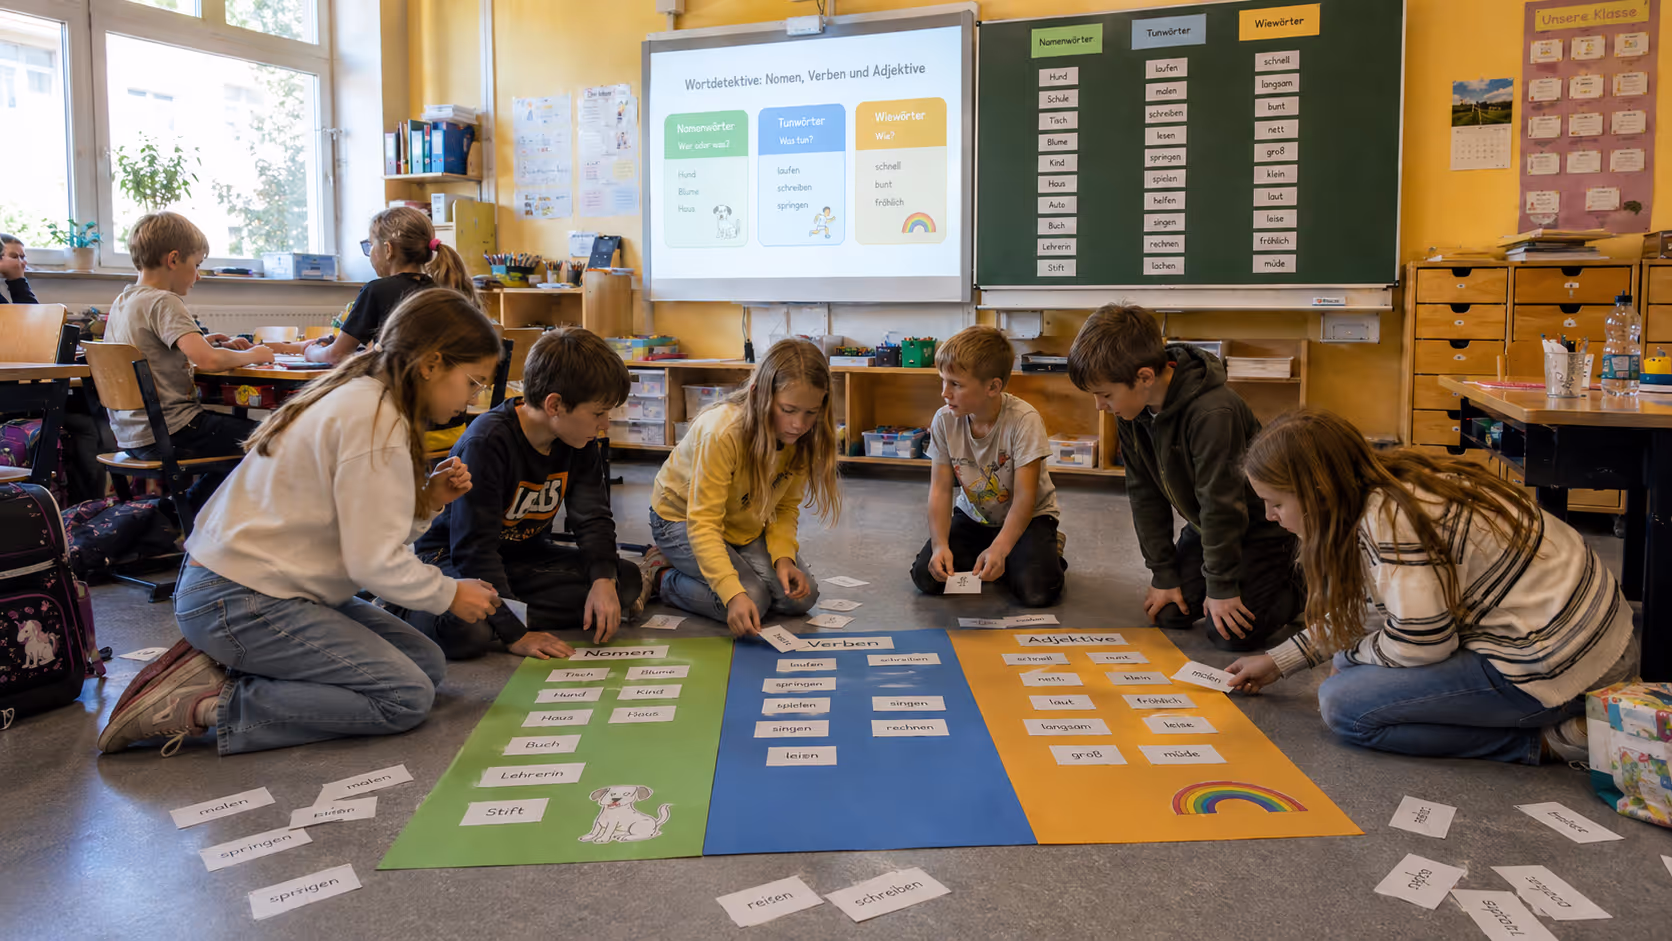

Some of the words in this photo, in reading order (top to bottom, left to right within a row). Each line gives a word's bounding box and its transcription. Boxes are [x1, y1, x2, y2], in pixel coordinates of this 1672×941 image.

[1542, 13, 1589, 25] Unsere
[1594, 8, 1637, 20] Klasse
[1255, 17, 1304, 28] Wiewörter
[1147, 28, 1191, 37] Tunwörter
[1264, 56, 1290, 65] schnell
[1156, 62, 1178, 74] laufen
[685, 75, 762, 91] Wortdetektive:
[766, 73, 804, 84] Nomen,
[808, 69, 846, 81] Verben
[850, 65, 869, 78] und
[873, 63, 925, 79] Adjektive
[1050, 71, 1067, 82] Hund
[1262, 80, 1292, 90] langsam
[1156, 85, 1177, 96] malen
[1048, 94, 1069, 103] Schule
[1268, 101, 1285, 112] bunt
[875, 111, 925, 122] Wiewörter
[1149, 109, 1183, 118] schreiben
[778, 117, 825, 128] Tunwörter
[1050, 115, 1067, 125] Tisch
[1268, 125, 1284, 135] nett
[779, 135, 795, 146] Was
[796, 135, 813, 144] tun?
[875, 131, 895, 140] Wie?
[1157, 130, 1175, 141] lesen
[1047, 137, 1067, 147] Blume
[1050, 158, 1064, 168] Kind
[1150, 153, 1181, 163] springen
[778, 165, 800, 176] laufen
[875, 161, 901, 170] schnell
[1267, 168, 1285, 179] klein
[1049, 179, 1065, 189] Haus
[1153, 174, 1177, 184] spielen
[778, 182, 812, 193] schreiben
[875, 180, 892, 189] bunt
[1154, 195, 1176, 206] helfen
[1268, 191, 1283, 201] laut
[777, 201, 808, 211] springen
[875, 197, 904, 207] fröhlich
[1049, 200, 1065, 210] Auto
[1154, 217, 1176, 228] singen
[1267, 213, 1284, 224] leise
[1048, 221, 1065, 231] Buch
[1150, 239, 1179, 249] rechnen
[1260, 235, 1289, 246] fröhlich
[1043, 241, 1071, 252] Lehrerin
[1048, 262, 1064, 273] Stift
[1152, 260, 1175, 271] lachen
[1265, 258, 1285, 269] müde
[808, 639, 879, 649] Verben
[1029, 635, 1116, 645] Adjektive
[584, 649, 654, 658] Nomen
[637, 688, 664, 696] Kind
[890, 699, 928, 708] singen
[1049, 698, 1074, 706] laut
[542, 714, 573, 722] Haus
[773, 724, 811, 733] singen
[887, 723, 934, 731] rechnen
[1041, 722, 1091, 732] langsam
[526, 740, 559, 749] Buch
[1072, 750, 1102, 760] groß
[1164, 749, 1200, 758] müde
[501, 770, 563, 780] Lehrerin
[347, 775, 391, 789] malen
[200, 800, 248, 815] malen
[486, 807, 524, 816] Stift
[220, 835, 292, 858] springen
[855, 880, 923, 907] schreiben
